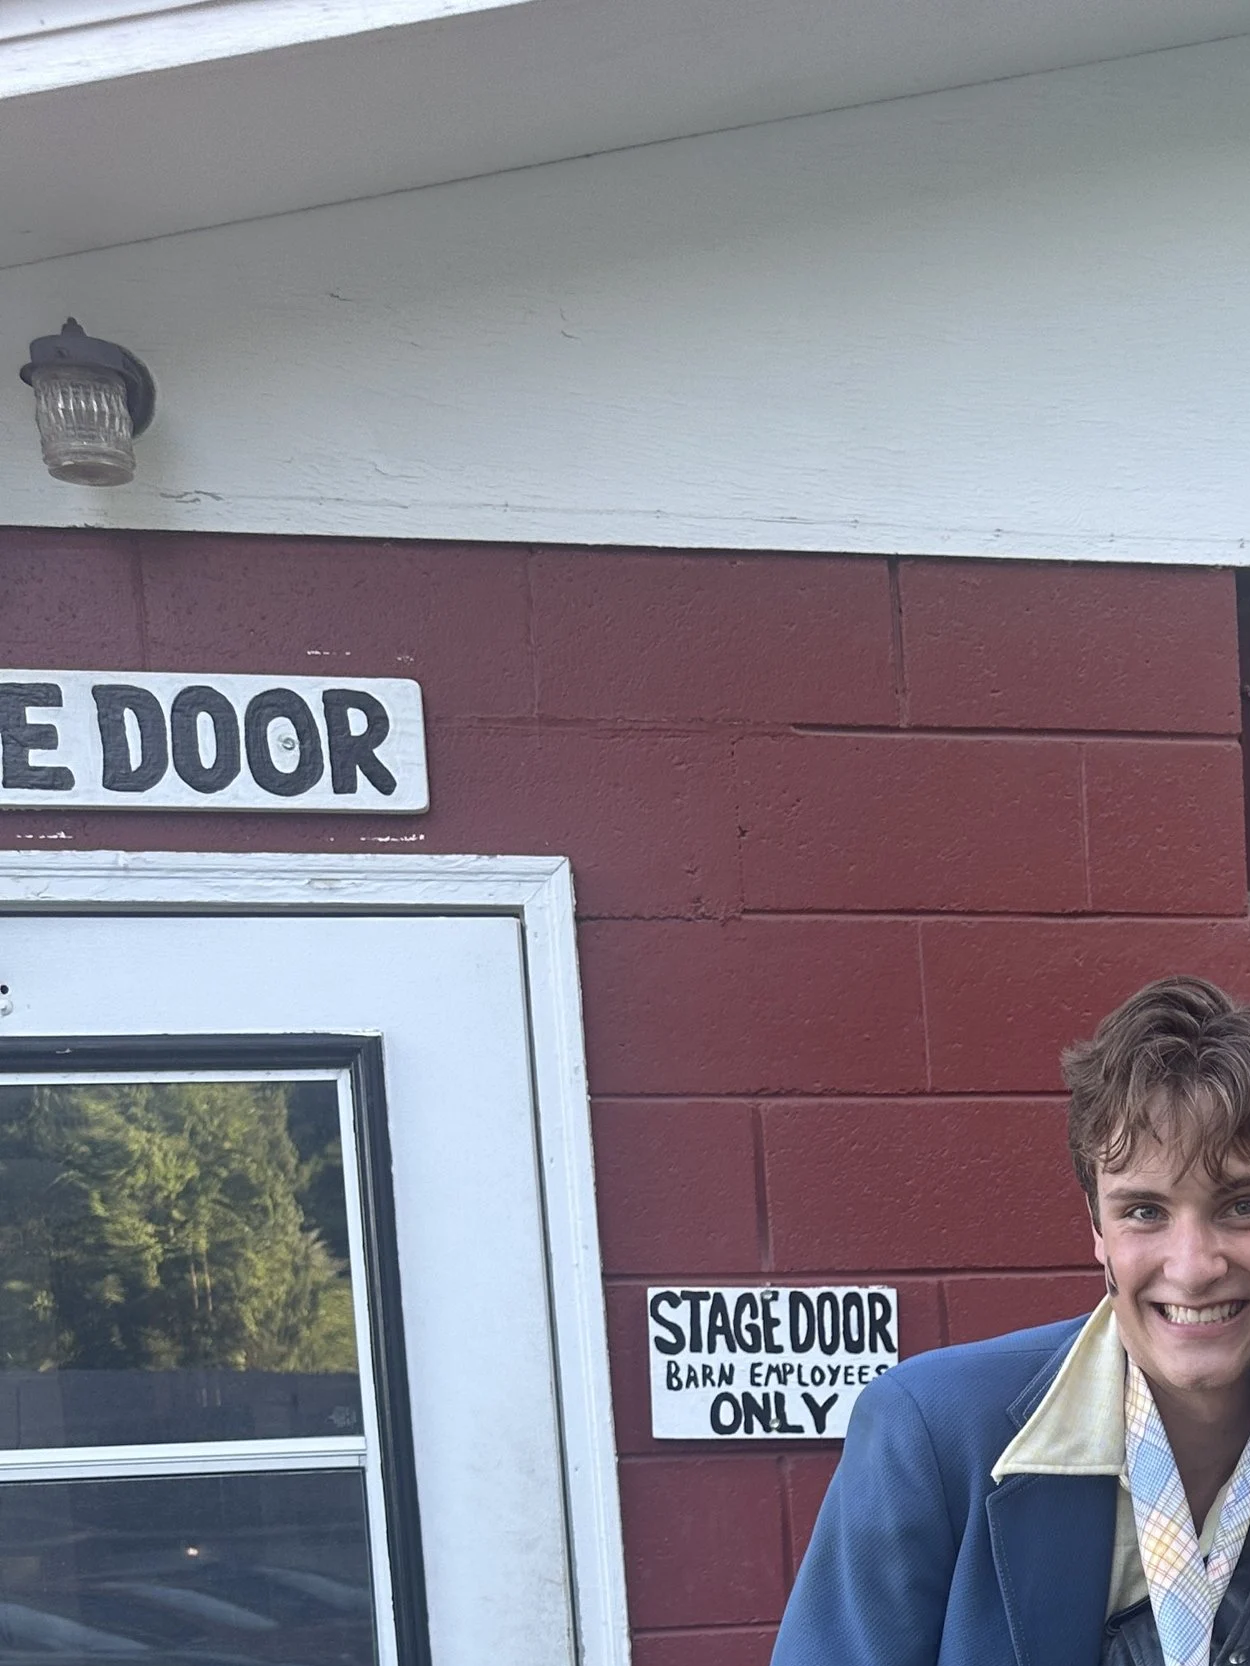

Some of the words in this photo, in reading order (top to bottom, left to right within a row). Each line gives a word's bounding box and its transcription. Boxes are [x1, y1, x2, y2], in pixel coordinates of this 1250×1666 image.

[91, 684, 397, 796] DOOR
[650, 1290, 784, 1355] STAGE
[789, 1291, 897, 1355] DOOR
[666, 1360, 735, 1391] BARN
[710, 1391, 839, 1435] ONLY
